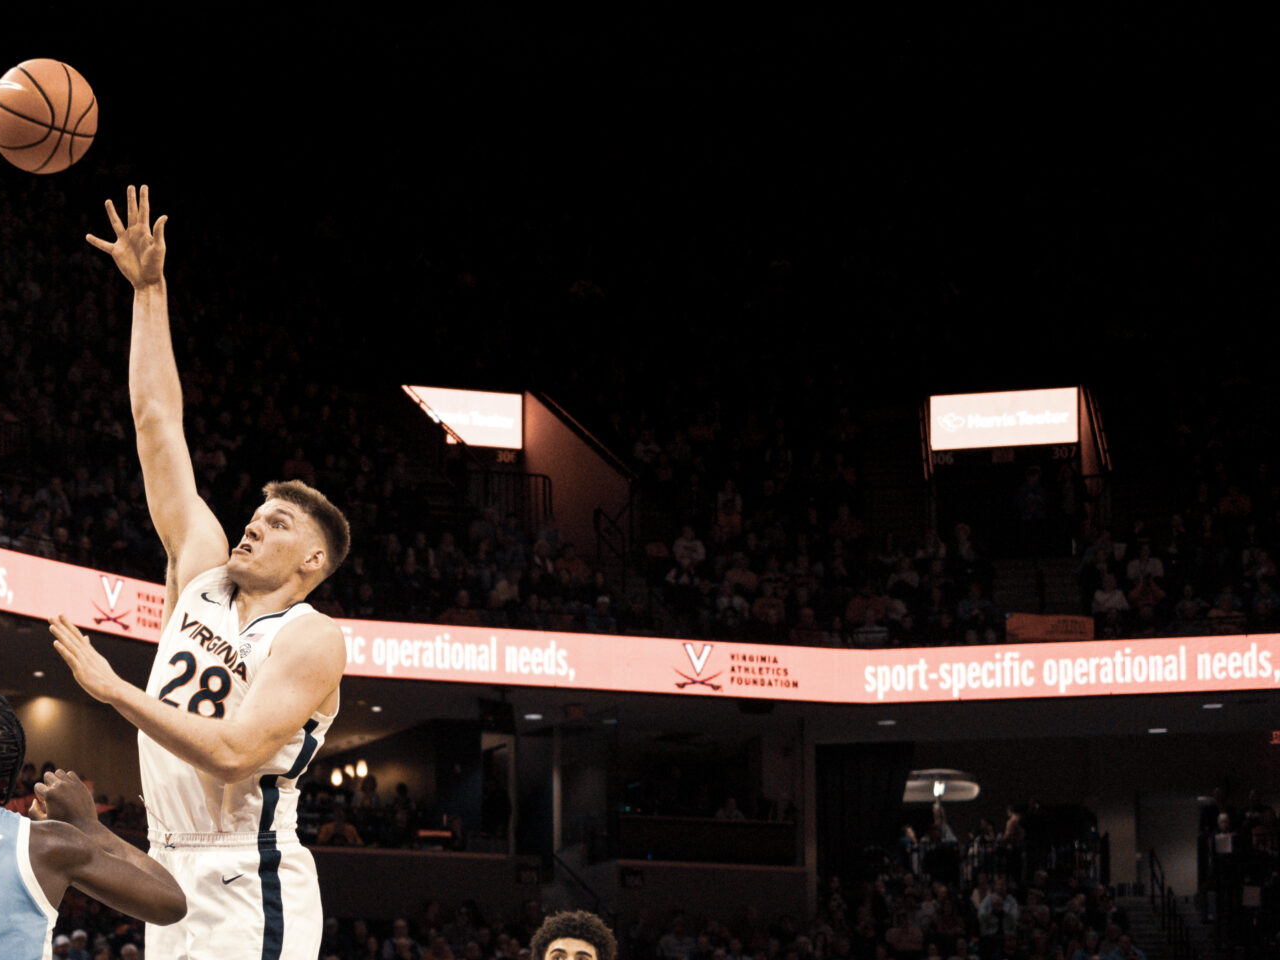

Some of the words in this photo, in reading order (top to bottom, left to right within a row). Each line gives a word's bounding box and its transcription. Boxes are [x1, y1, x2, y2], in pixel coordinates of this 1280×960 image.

[179, 612, 248, 683] VIRGINIA
[372, 633, 498, 674] operational
[505, 640, 576, 682] needs,
[729, 653, 779, 664] VIRGINIA
[729, 665, 789, 677] ATHLETICS
[864, 651, 1036, 700] sport-specific
[1042, 645, 1187, 694] operational
[1197, 642, 1280, 683] needs,
[158, 650, 232, 720] 28
[729, 676, 800, 689] FOUNDATION
